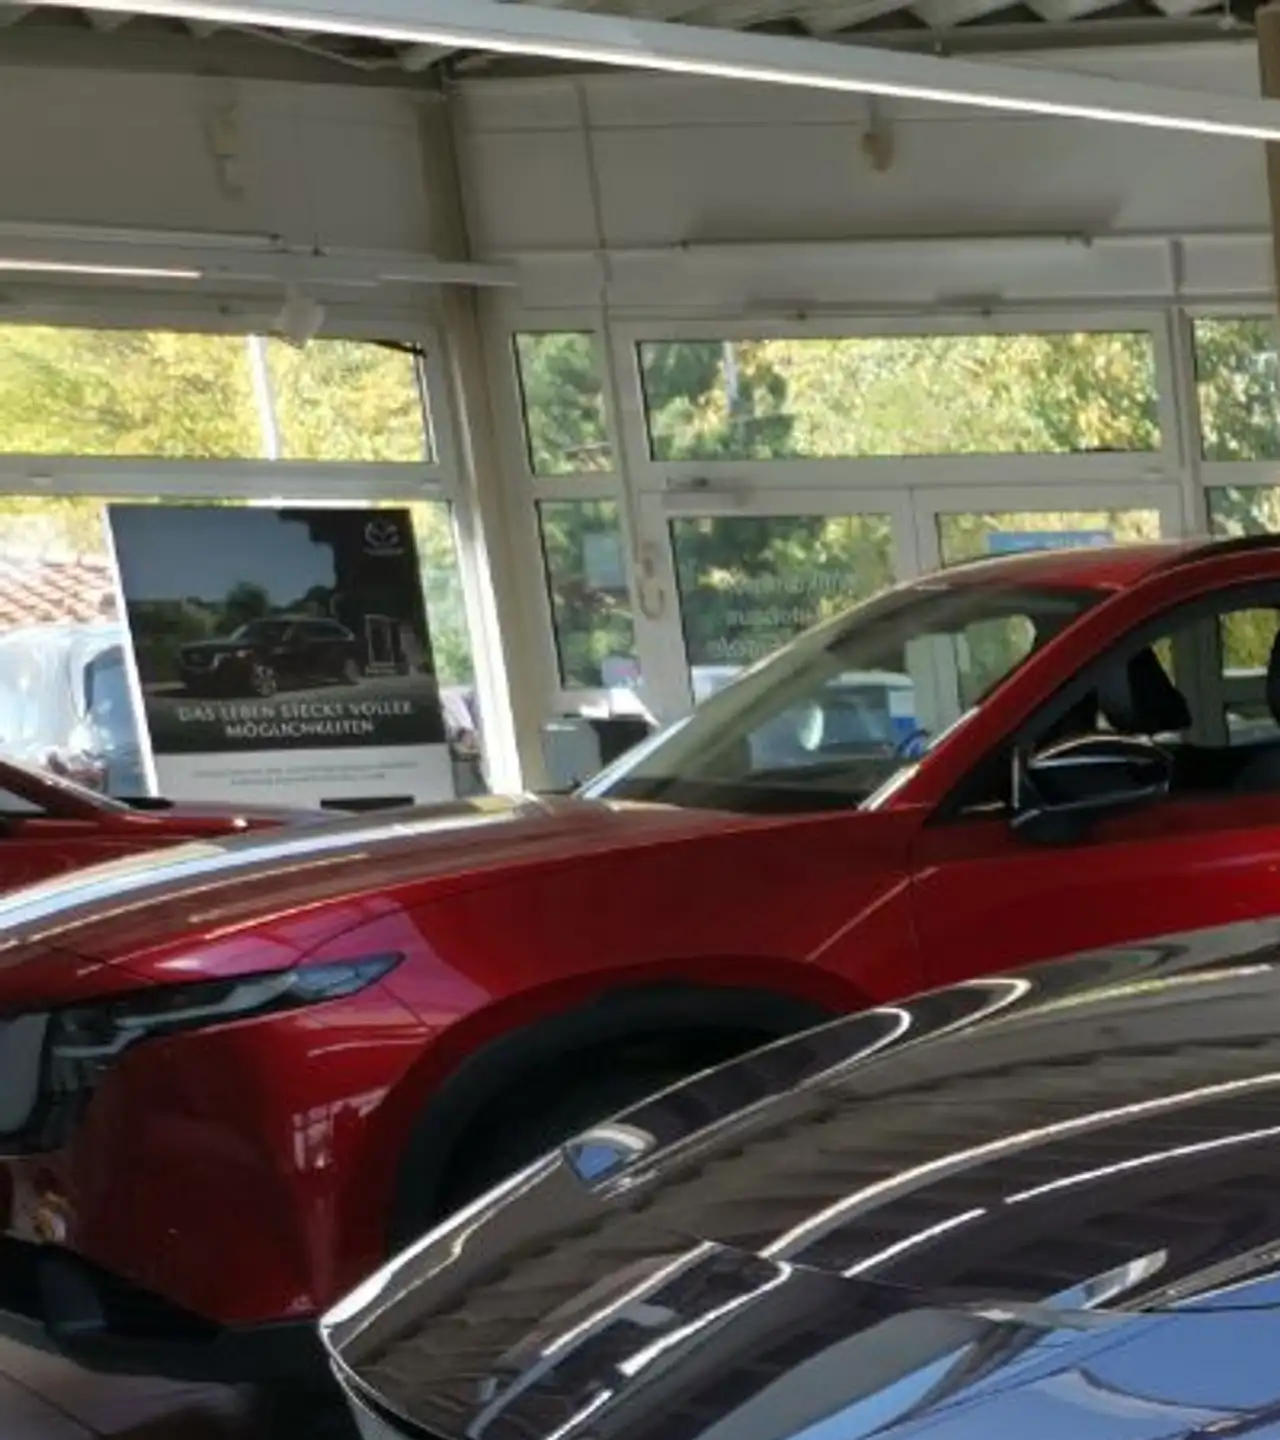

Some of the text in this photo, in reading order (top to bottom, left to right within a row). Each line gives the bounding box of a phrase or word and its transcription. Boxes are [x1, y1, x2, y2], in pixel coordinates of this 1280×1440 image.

[177, 700, 414, 722] DAS LEBEN STECKT VOLLER
[225, 719, 375, 738] MÖGLICHKEITEN
